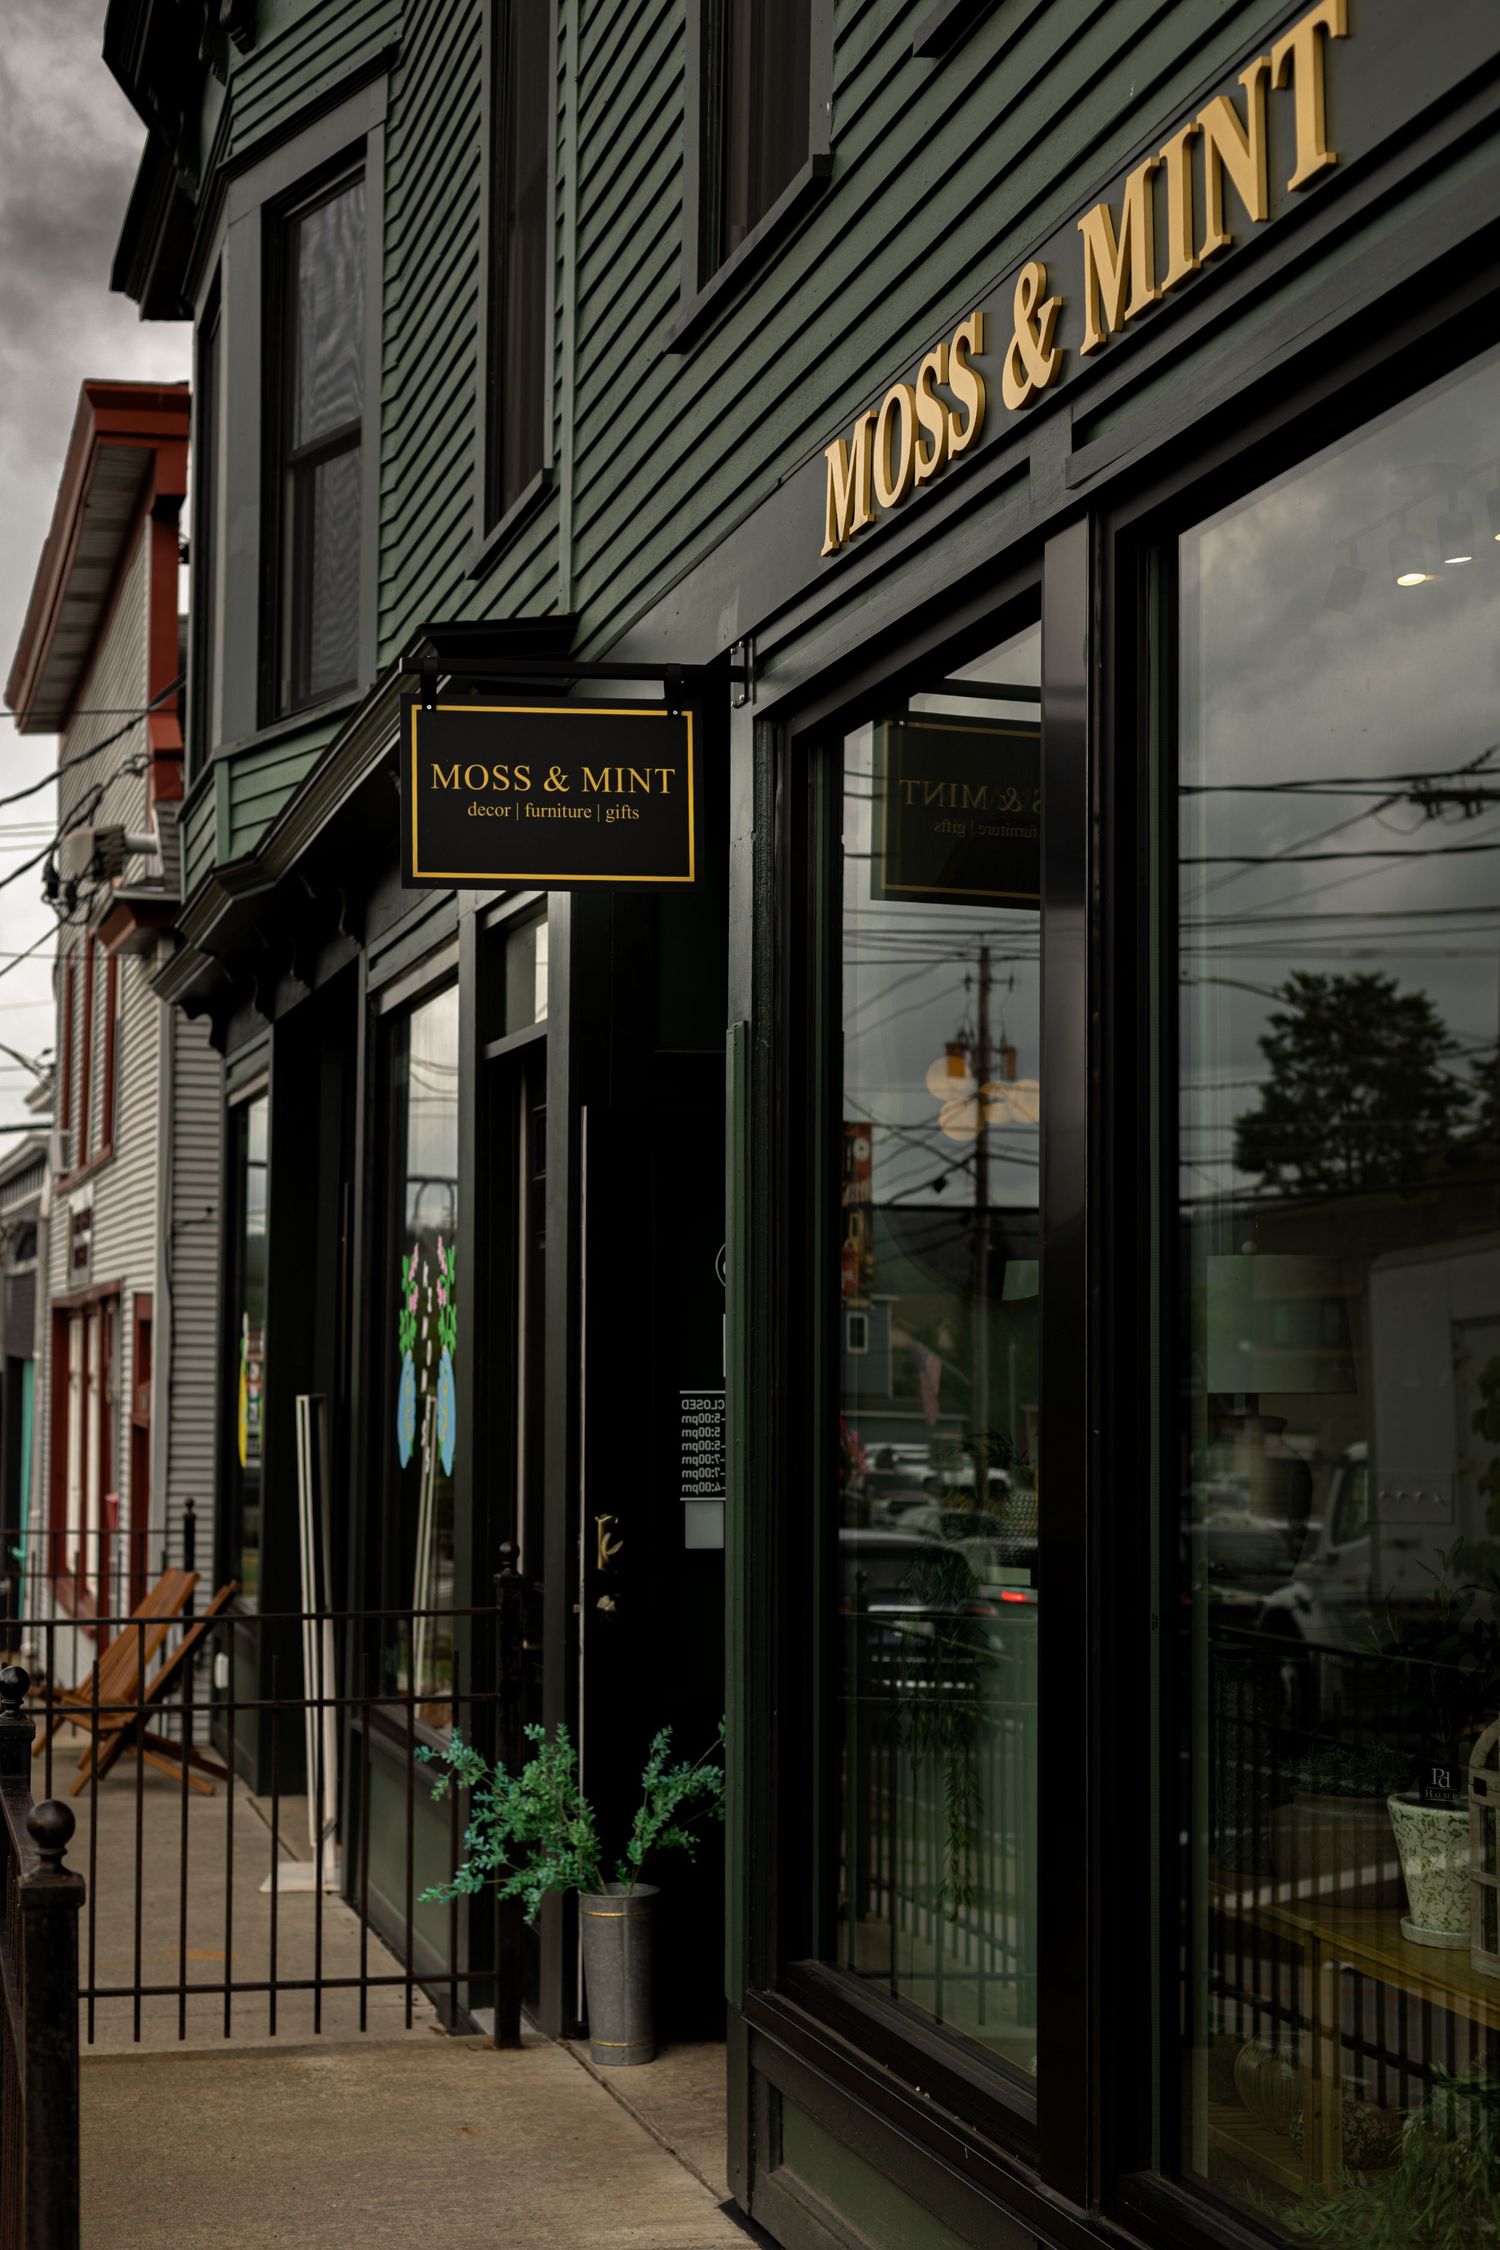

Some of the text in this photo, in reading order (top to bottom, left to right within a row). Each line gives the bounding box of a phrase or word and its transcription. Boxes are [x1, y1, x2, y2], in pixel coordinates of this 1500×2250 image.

[821, 0, 1348, 557] MOSS & MINT
[430, 763, 676, 794] MOSS & MINT
[467, 802, 511, 817] decor
[524, 803, 592, 819] furniture
[605, 804, 640, 823] gifts
